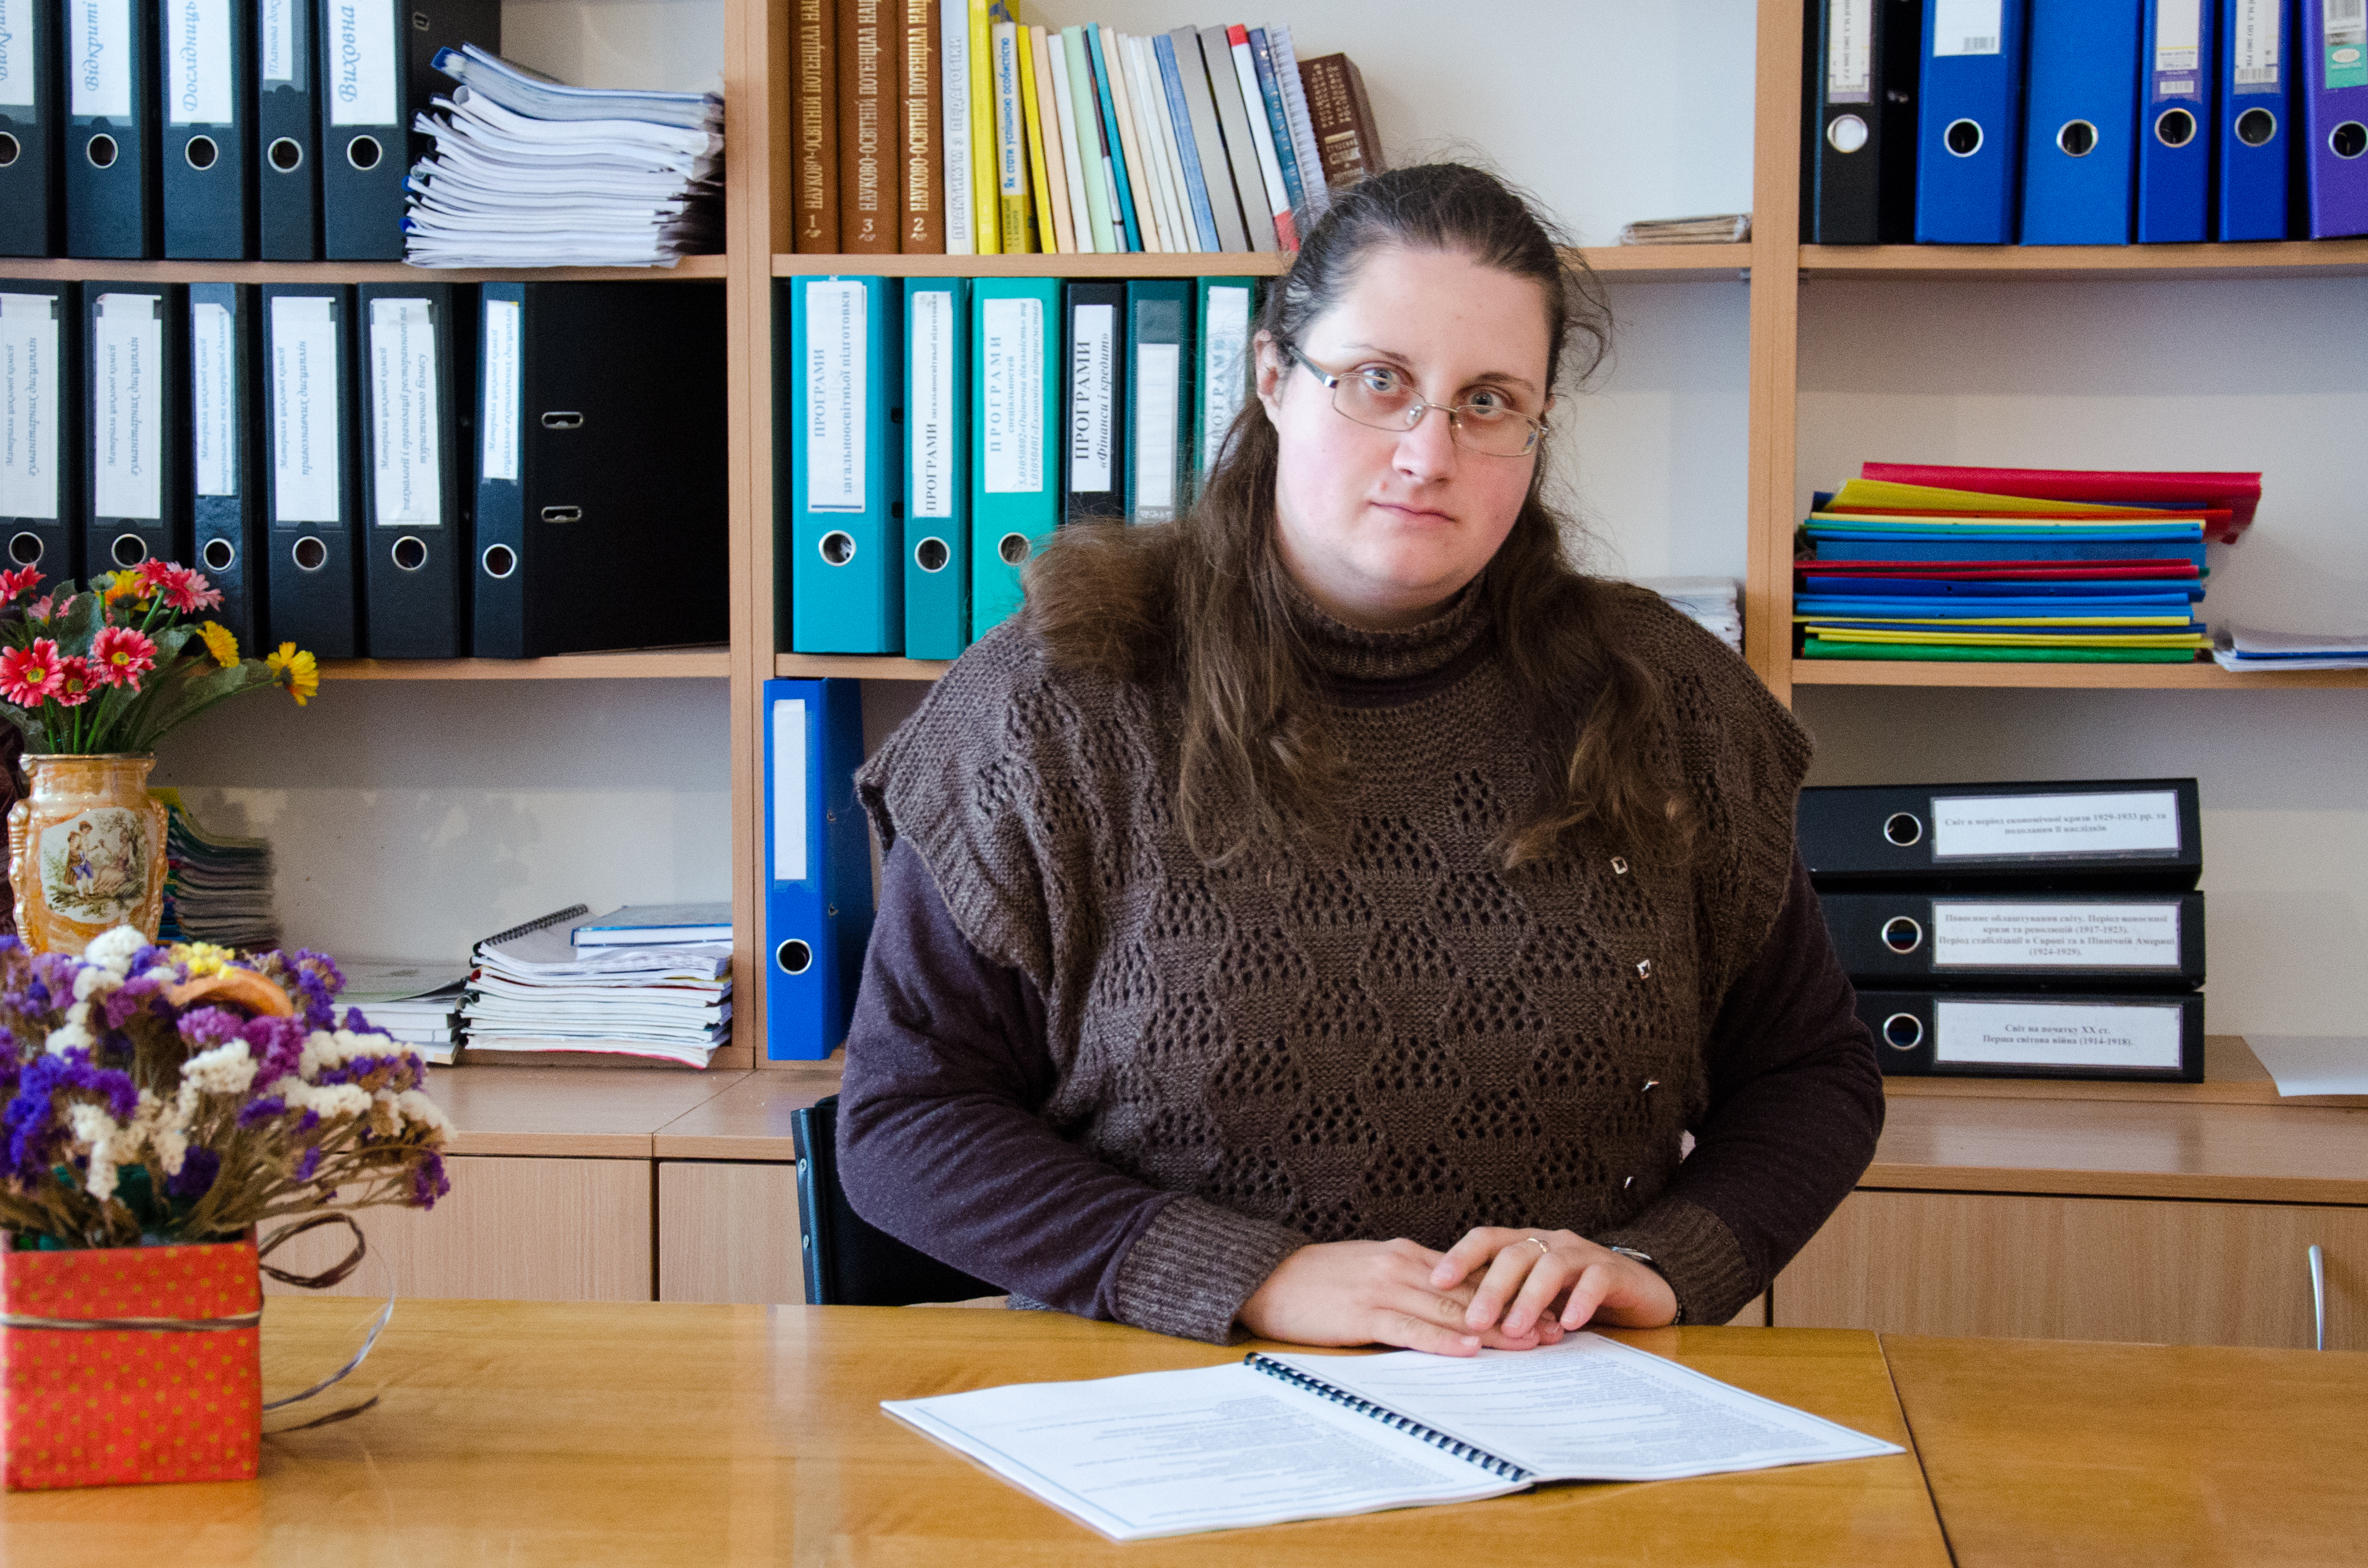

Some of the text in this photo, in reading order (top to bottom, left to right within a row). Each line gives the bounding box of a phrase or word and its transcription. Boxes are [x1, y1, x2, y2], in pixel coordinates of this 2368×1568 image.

[82, 1, 104, 92] Відкриті
[338, 5, 361, 102] Виховна
[948, 36, 964, 131] ПЕДАГОГІКИ
[951, 150, 965, 239] ПРАКТИКУМ
[1005, 176, 1016, 189] Як
[809, 215, 816, 228] 1
[863, 219, 873, 231] 3
[914, 217, 924, 231] 2
[6, 344, 15, 374] комісії
[109, 344, 117, 374] комісії
[278, 347, 287, 376] комісії
[380, 348, 388, 377] комісії
[1098, 333, 1111, 392] кредит»
[26, 337, 40, 476] гуманітарних дисциплін
[127, 337, 142, 475] гуманітарних дисциплін
[297, 341, 312, 475] правознавчих дисциплін
[416, 353, 429, 464] туристичного бізнесу
[813, 349, 826, 437] ПРОГРАМИ
[839, 290, 852, 495] загальноосвітньої підготовки
[989, 336, 1002, 452] ПРОГРАМИ
[1007, 356, 1016, 433] спеціальностей
[1075, 341, 1090, 460] ПРОГРАМИ
[6, 417, 16, 466] Матеріали
[109, 417, 119, 466] Матеріали
[280, 420, 289, 469] Матеріали
[381, 421, 390, 469] Матеріали
[401, 396, 411, 448] організації
[1097, 402, 1109, 469] «Фінанси
[925, 423, 938, 511] ПРОГРАМИ
[2094, 812, 2138, 821] 1929-1933
[1983, 1036, 2014, 1045] Перша
[2052, 1036, 2077, 1044] війна
[2005, 1024, 2026, 1032] Світ
